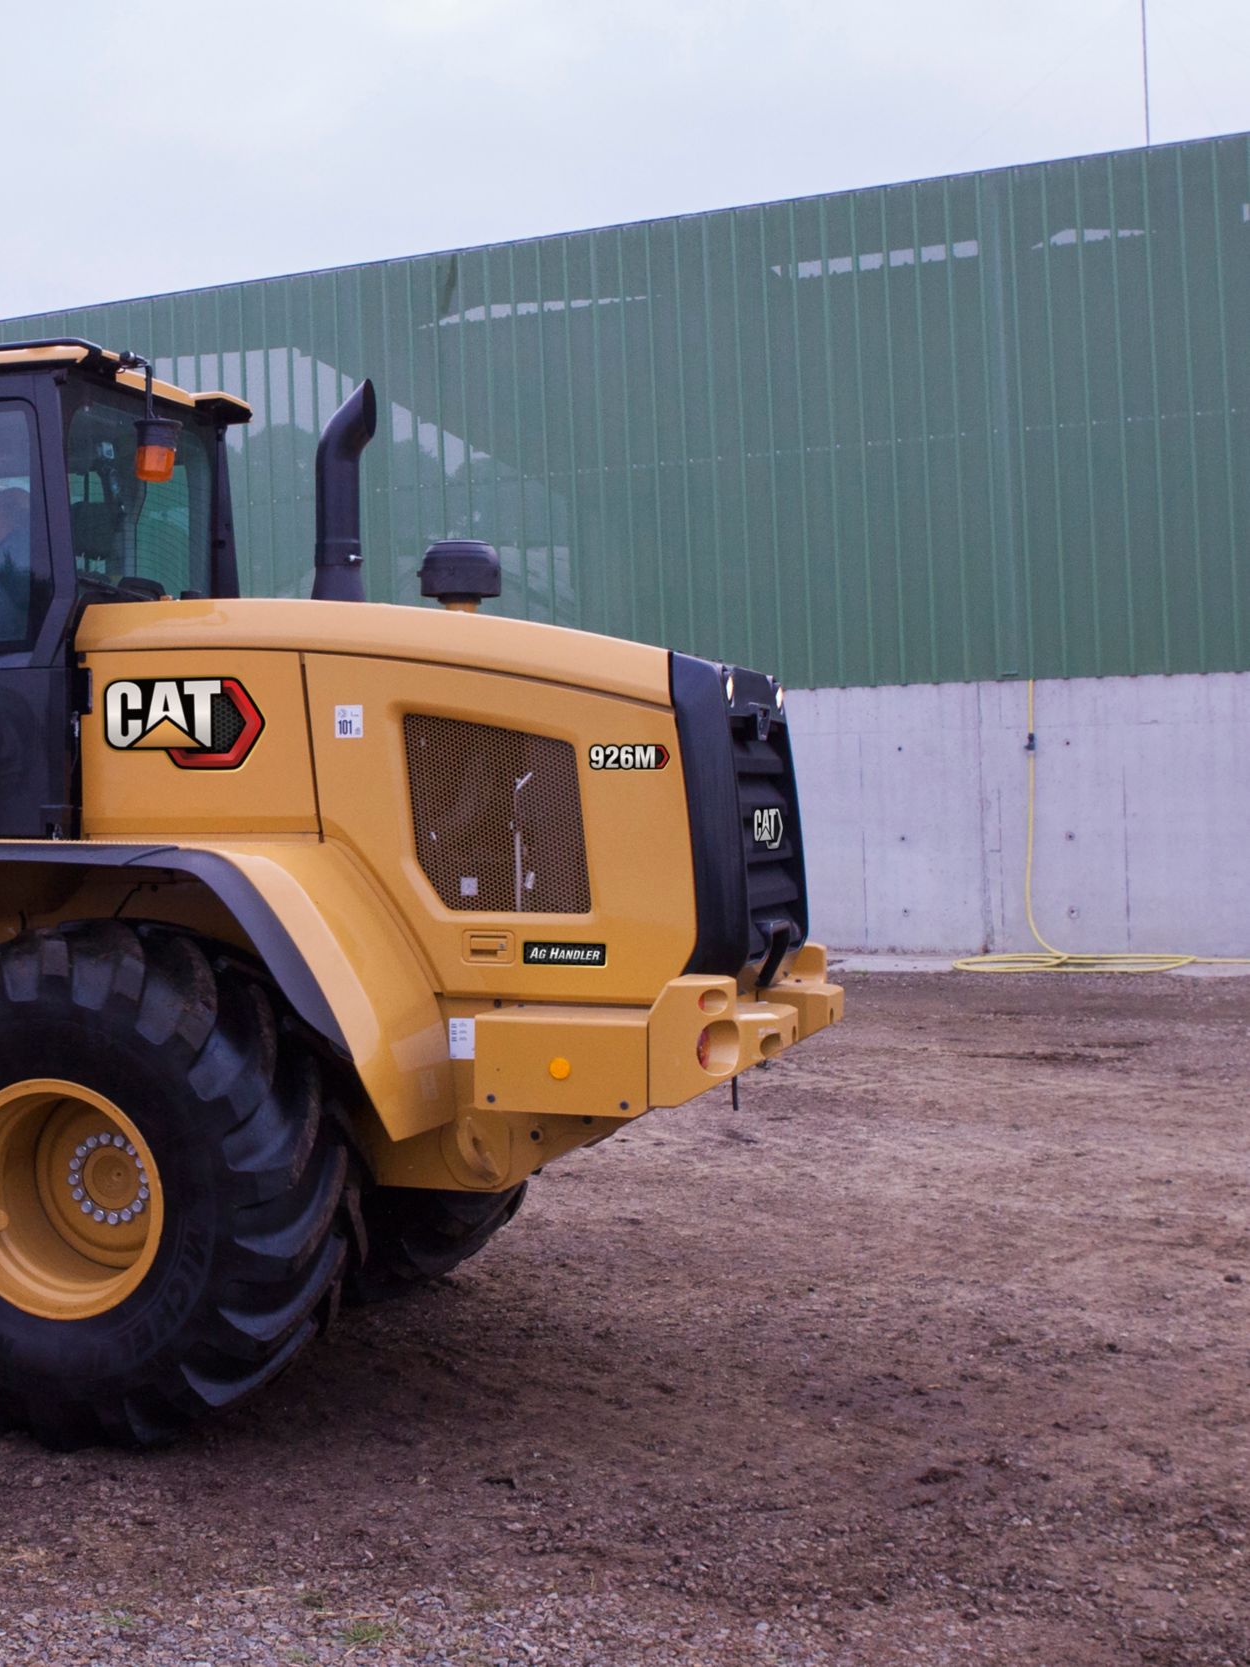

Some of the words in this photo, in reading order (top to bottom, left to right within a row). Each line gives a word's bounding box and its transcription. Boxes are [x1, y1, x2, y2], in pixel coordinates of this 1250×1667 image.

[106, 680, 221, 747] CAT
[338, 719, 352, 735] 101
[590, 745, 655, 768] 926M
[754, 809, 776, 842] CAT
[62, 1216, 213, 1376] MICHEL
